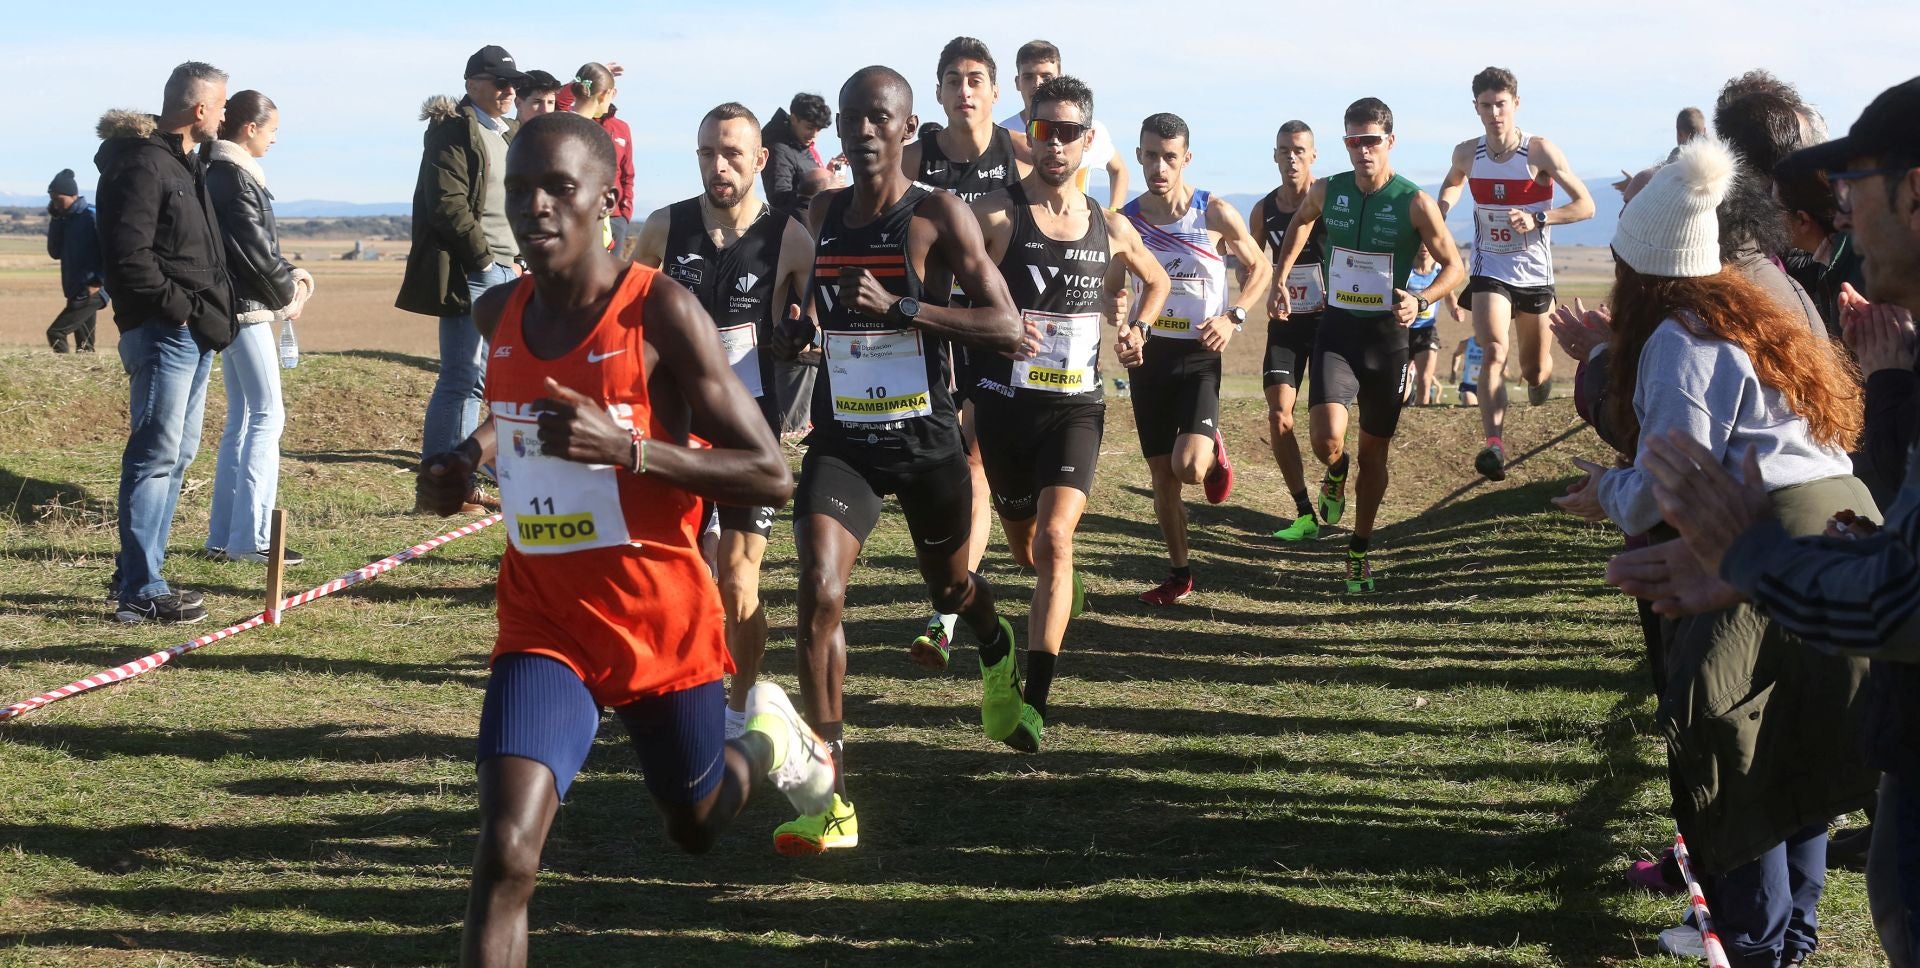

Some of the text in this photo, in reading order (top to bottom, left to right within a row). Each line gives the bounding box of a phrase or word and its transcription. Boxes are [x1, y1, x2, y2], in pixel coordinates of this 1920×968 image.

[1490, 228, 1512, 242] 56
[1064, 248, 1106, 263] BIKILA
[1065, 289, 1098, 299] FOODS
[1289, 286, 1308, 300] 97
[1352, 284, 1360, 293] 6
[1336, 292, 1384, 304] PANIAGUA
[1166, 308, 1174, 317] 3
[861, 343, 892, 351] Diputación
[1059, 357, 1068, 368] 1
[1028, 370, 1083, 384] GUERRA
[865, 386, 887, 399] 10
[836, 396, 927, 412] NAZAMBIMANA
[529, 496, 555, 515] 11
[518, 518, 595, 540] KIPTOO
